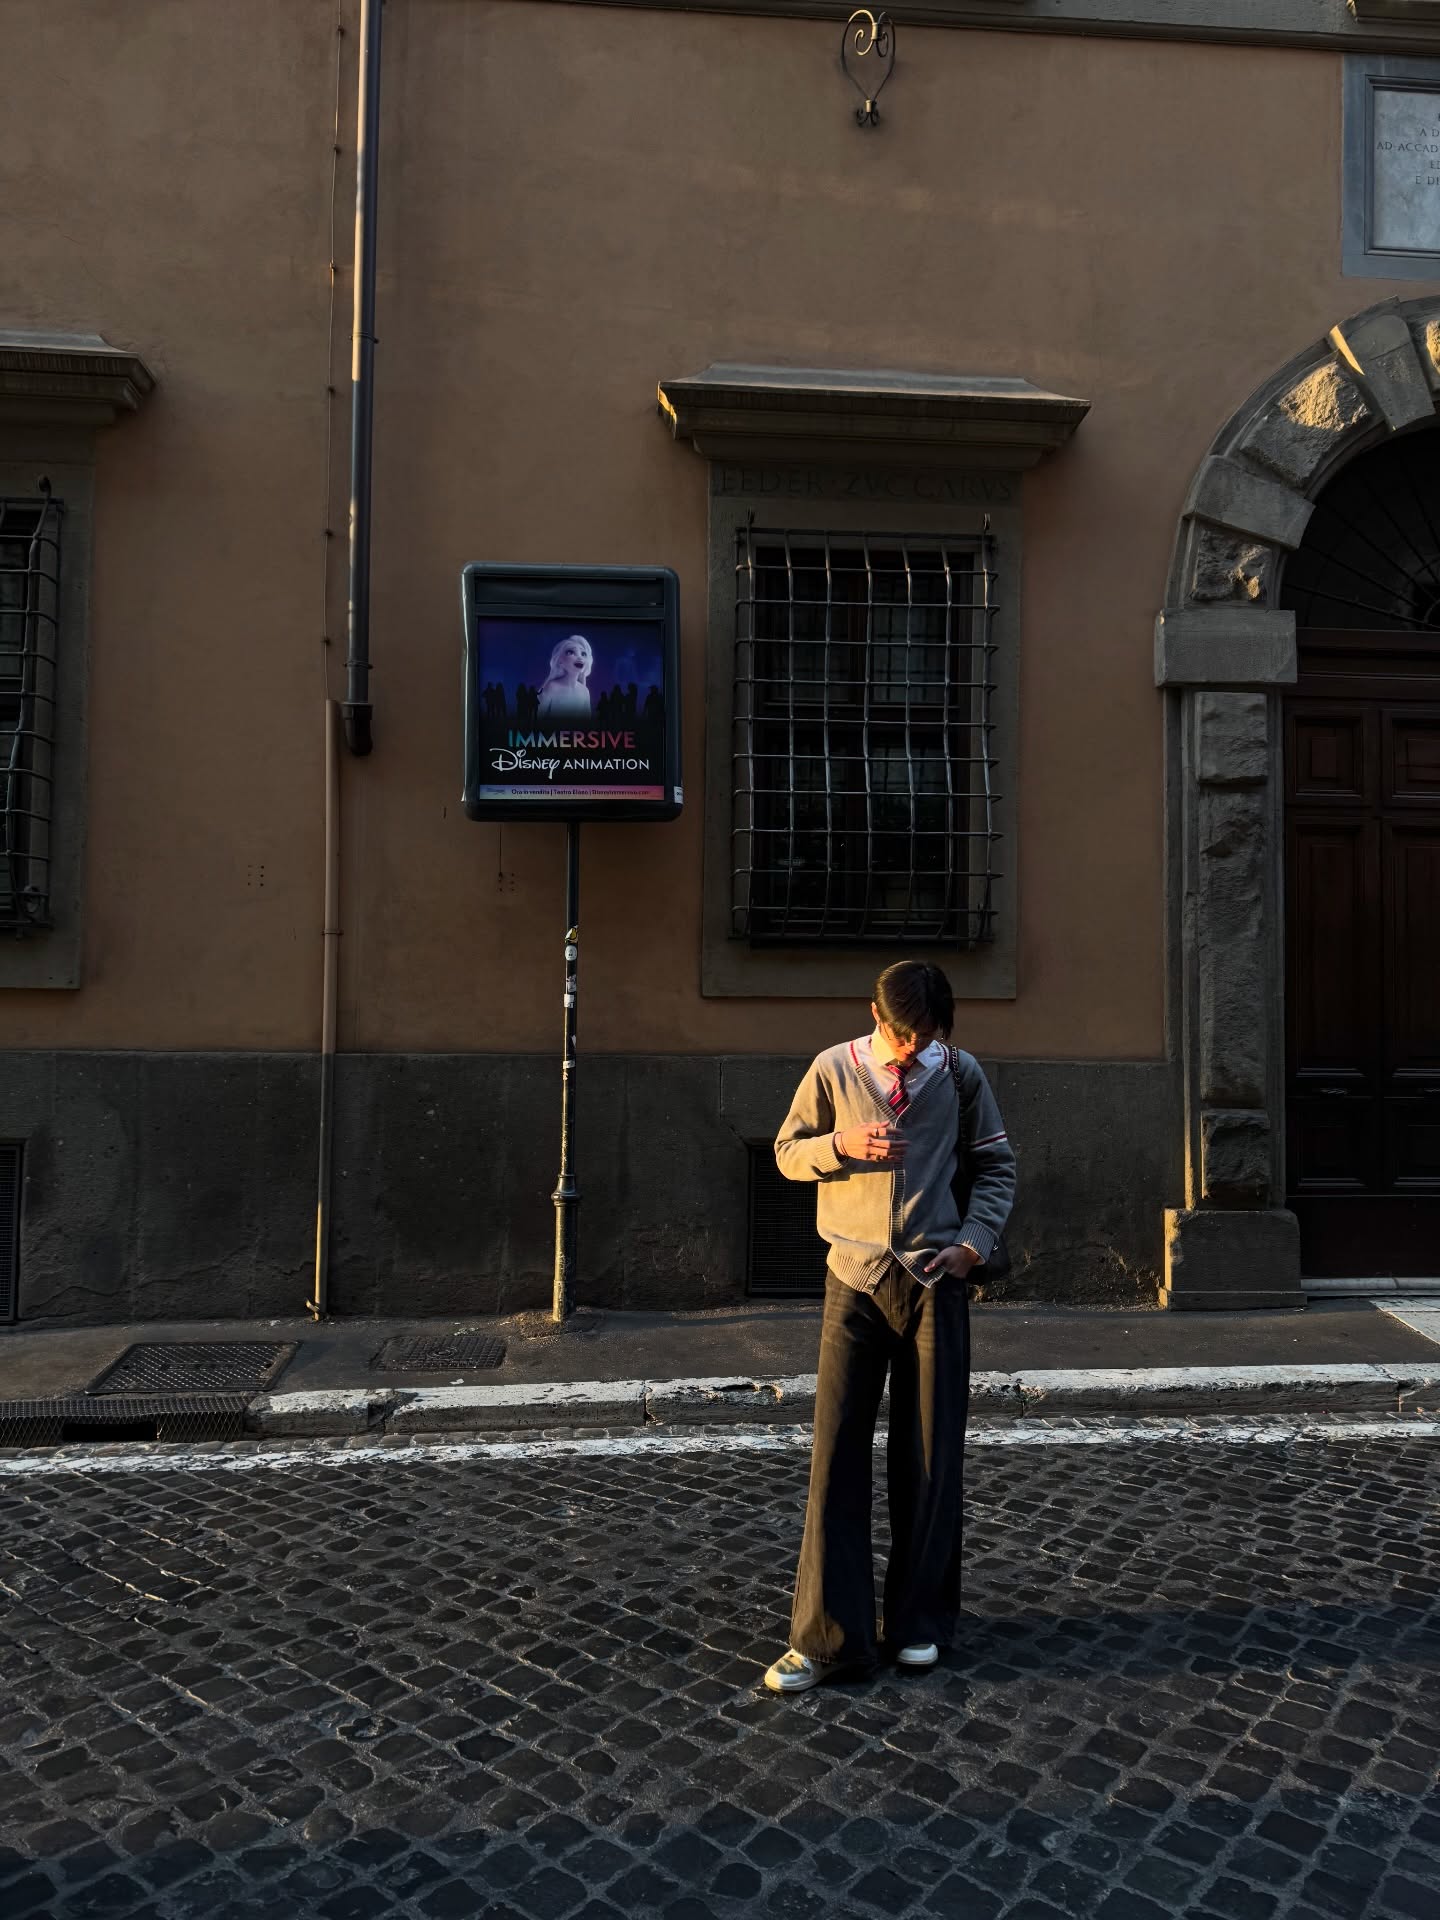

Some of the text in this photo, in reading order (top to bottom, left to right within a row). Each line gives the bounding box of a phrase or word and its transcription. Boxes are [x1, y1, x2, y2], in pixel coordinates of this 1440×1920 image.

[508, 729, 636, 749] IMMERSIVE
[489, 747, 650, 779] Disney ANIMATION
